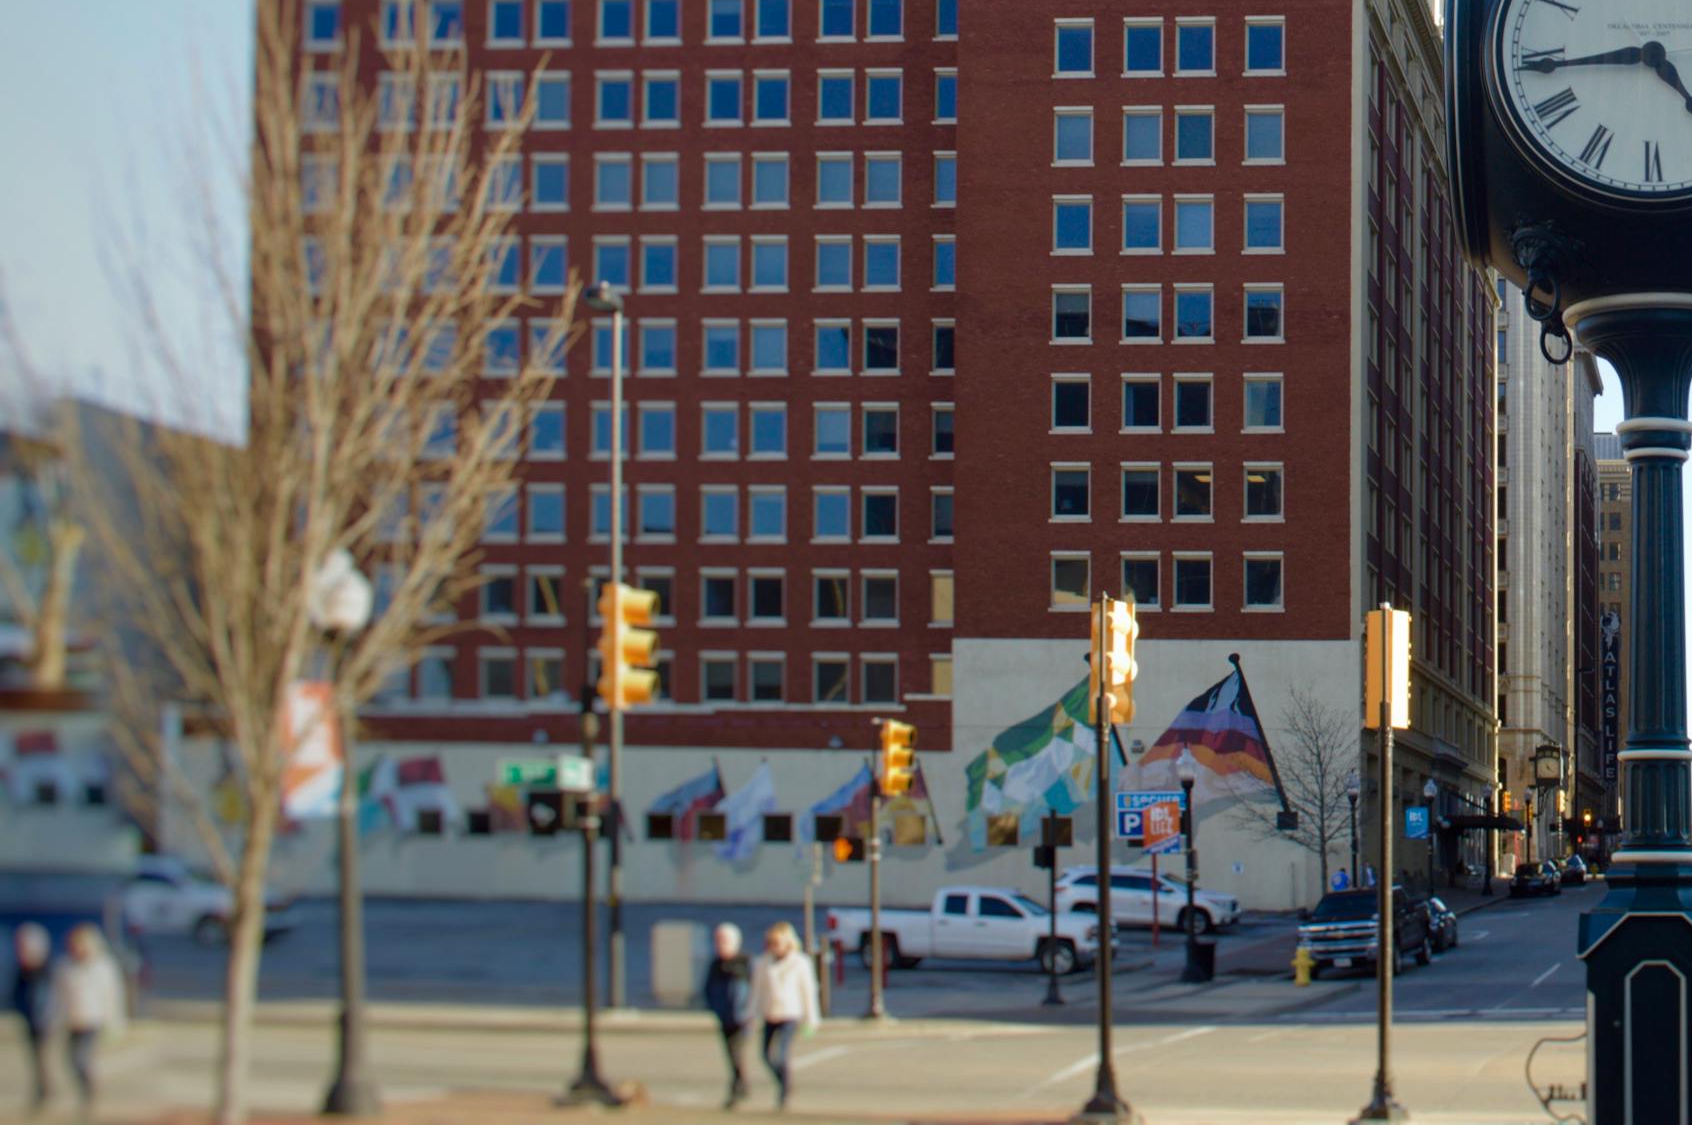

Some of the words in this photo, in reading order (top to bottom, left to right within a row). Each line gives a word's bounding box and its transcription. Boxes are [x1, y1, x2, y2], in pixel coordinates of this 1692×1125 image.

[1533, 85, 1581, 130] VIII
[1578, 123, 1615, 170] VII
[1643, 140, 1663, 182] VI
[1604, 651, 1616, 718] ATLAS
[1605, 725, 1615, 778] LIFE
[1124, 813, 1140, 834] P
